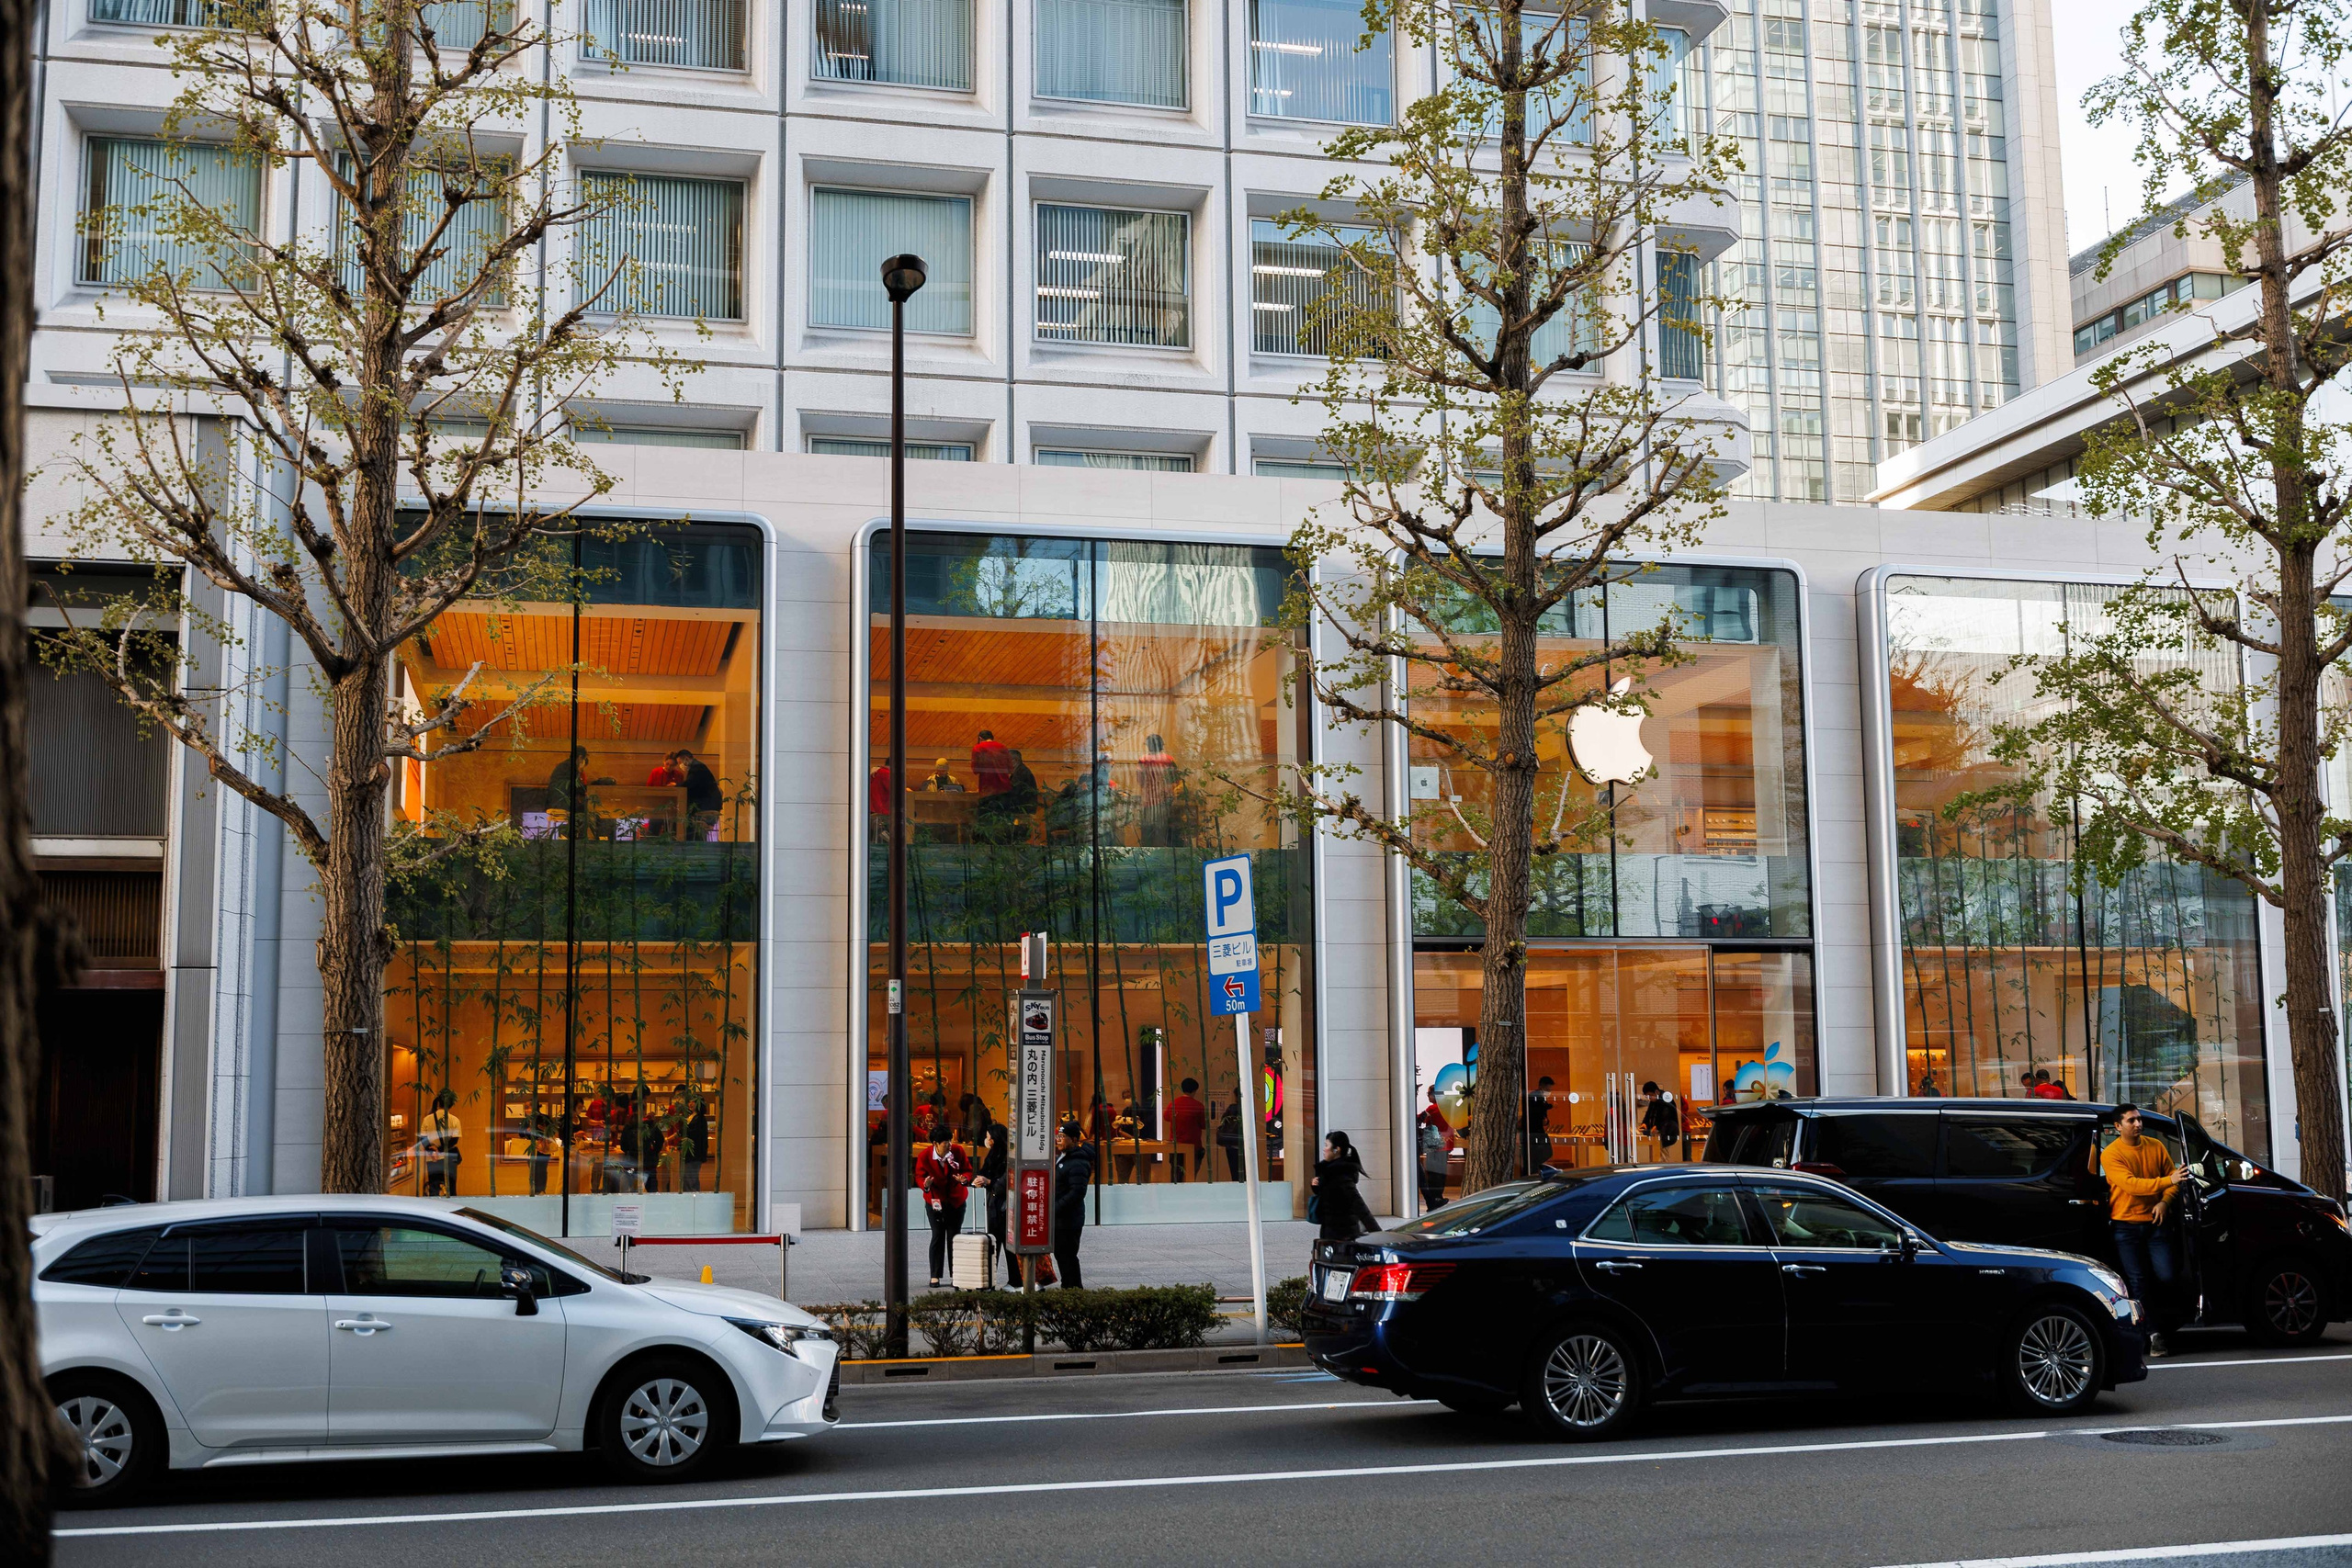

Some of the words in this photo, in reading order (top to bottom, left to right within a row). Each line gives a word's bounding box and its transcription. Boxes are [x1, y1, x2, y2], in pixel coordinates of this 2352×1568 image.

[1214, 868, 1243, 928] P
[1213, 940, 1252, 959] 三菱ビル
[1226, 999, 1246, 1012] 50m
[1035, 1033, 1049, 1042] Stop
[1027, 1048, 1038, 1086] 丸の内
[1026, 1089, 1038, 1137] 三菱ビル
[1025, 1177, 1038, 1237] 駐停車禁止
